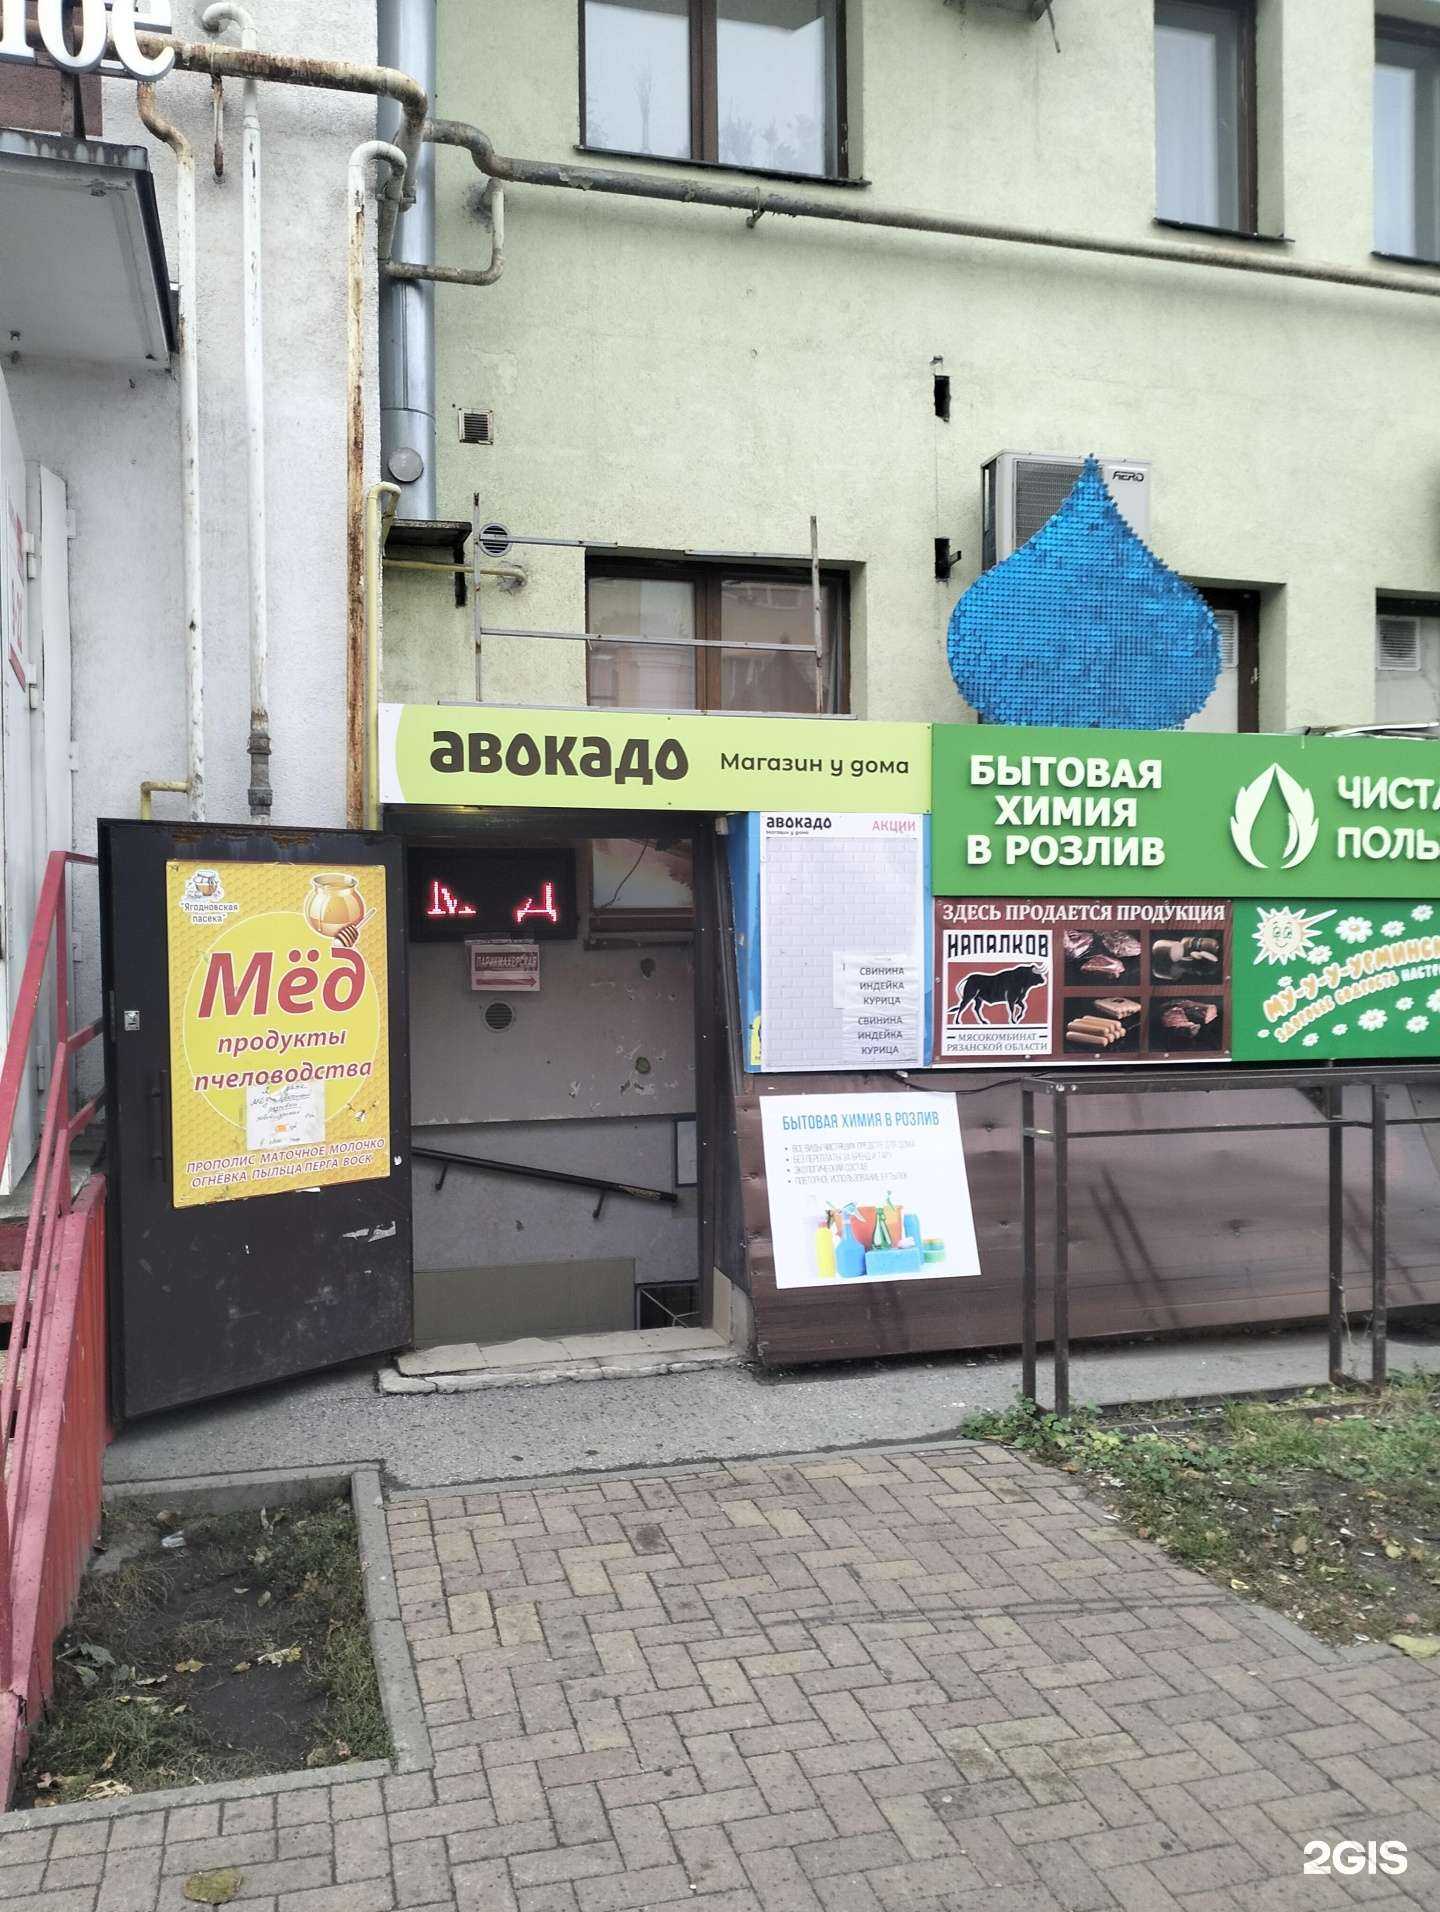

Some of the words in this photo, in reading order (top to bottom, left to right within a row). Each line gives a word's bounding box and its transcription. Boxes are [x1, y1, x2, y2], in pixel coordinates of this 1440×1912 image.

[429, 730, 689, 785] авокадо
[720, 752, 823, 773] Магазин
[830, 758, 844, 778] у
[850, 757, 909, 776] дома
[970, 755, 1163, 789] БЫТОВАЯ
[994, 795, 1138, 827] ХИМИЯ
[766, 816, 832, 831] авокадо
[872, 820, 916, 834] АКЦИИ
[967, 835, 993, 865] В
[1005, 835, 1166, 867] РОЗЛИВ
[943, 905, 1000, 922] ЗДЕСЬ
[1005, 904, 1112, 923] ПРОДАЕТСЯ
[1116, 904, 1226, 924] ПРОДУКЦИЯ
[948, 934, 1049, 958] НАПАЛКОВ
[859, 966, 905, 976] СВИНИНА
[198, 948, 366, 1018] Мёд
[859, 980, 905, 991] ИНДЕЙКА
[863, 996, 901, 1006] КУРИЦА
[857, 1016, 903, 1026] СВИНИНА
[217, 1029, 347, 1058] продукты
[857, 1029, 903, 1040] ИНДЕЙКА
[957, 1032, 1038, 1042] МЯСОКОМБИНАТ
[861, 1046, 900, 1055] КУРИЦА
[946, 1041, 1003, 1052] РЯЗАНСКОЙ
[1004, 1041, 1049, 1051] ОБЛАСТИ
[194, 1059, 373, 1092] пчеловодства
[782, 1114, 839, 1130] БЫТОВАЯ
[841, 1112, 882, 1129] ХИМИЯ
[886, 1112, 893, 1127] В
[895, 1111, 940, 1126] РОЗЛИВ
[186, 1156, 255, 1174] ПРОПОЛИС
[260, 1148, 326, 1164] МАТОЧНОЕ
[329, 1138, 385, 1155] МОЛОЧКО
[252, 1164, 302, 1180] ПЫЛЬЦА
[304, 1158, 338, 1172] ПЕРГА
[343, 1154, 373, 1166] ВОСК
